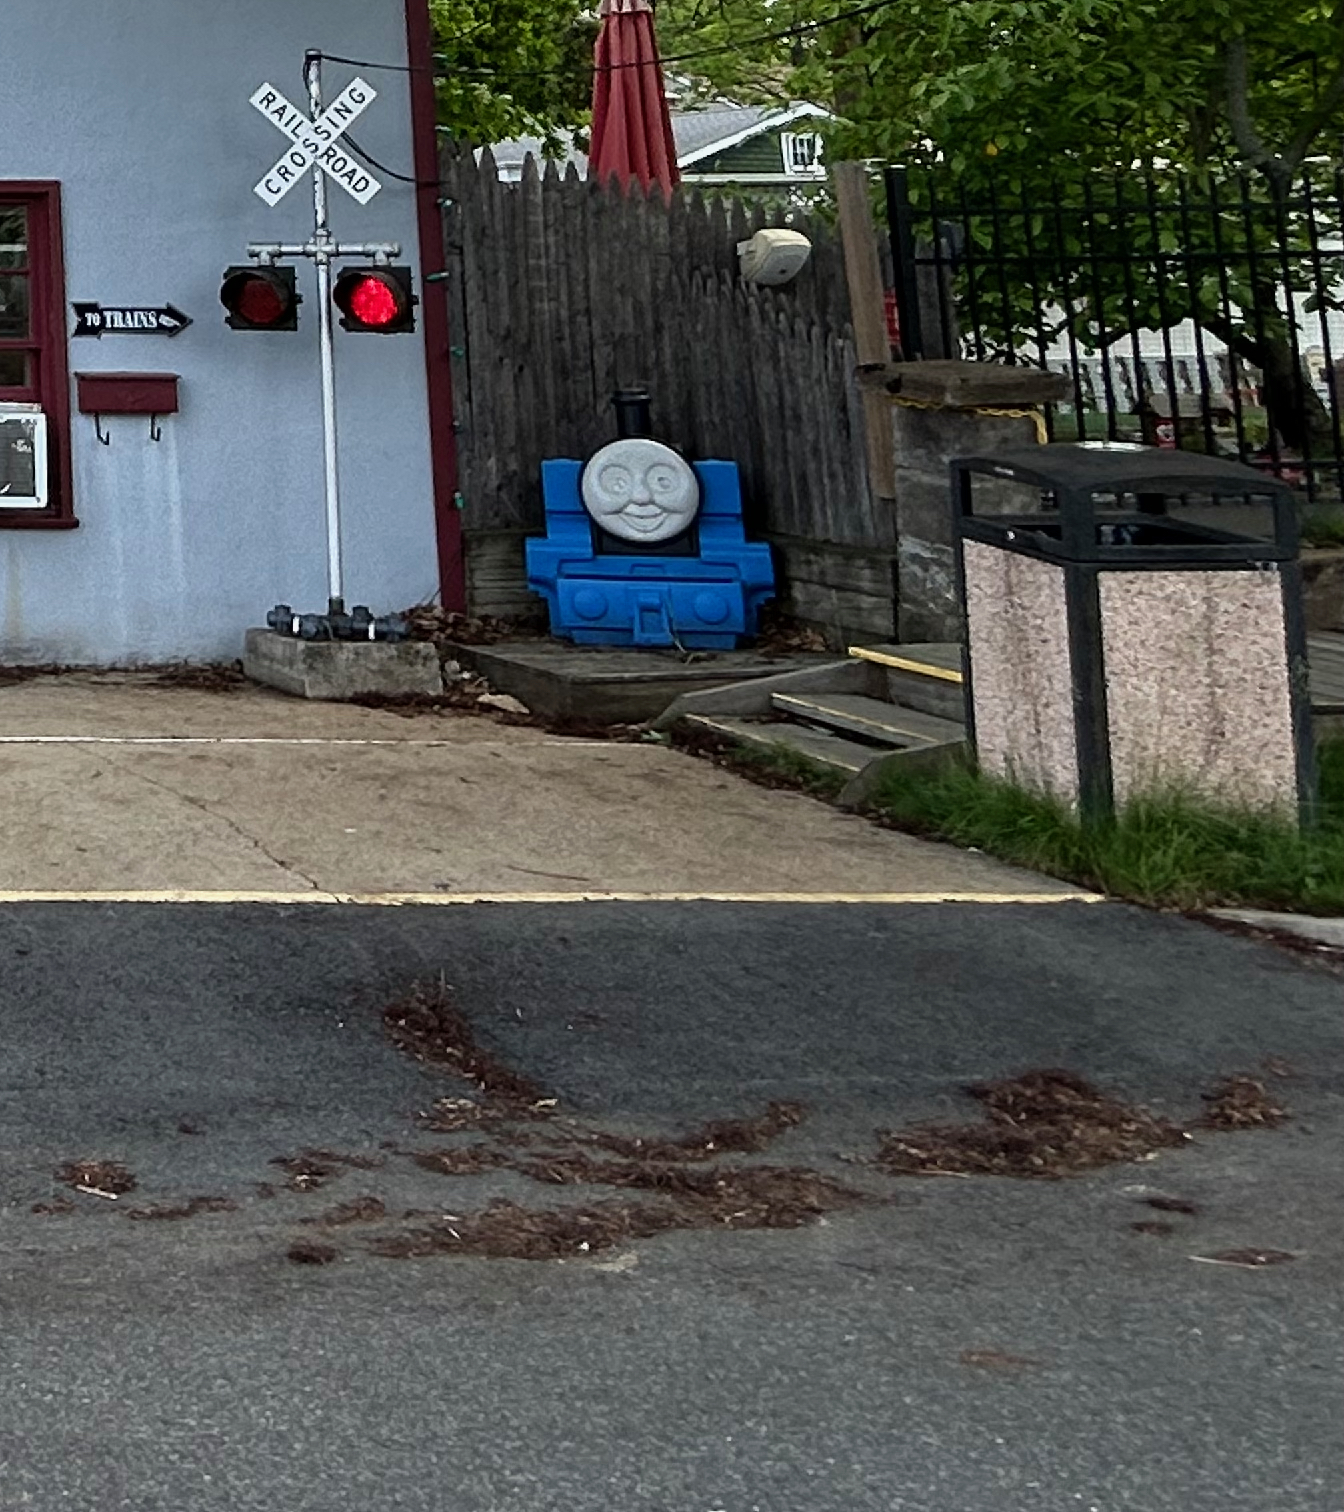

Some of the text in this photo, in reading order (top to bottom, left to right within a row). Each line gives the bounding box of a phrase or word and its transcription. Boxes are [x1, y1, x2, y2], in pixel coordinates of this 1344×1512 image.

[264, 86, 366, 196] CROSSING
[84, 310, 158, 328] TO TRAINS
